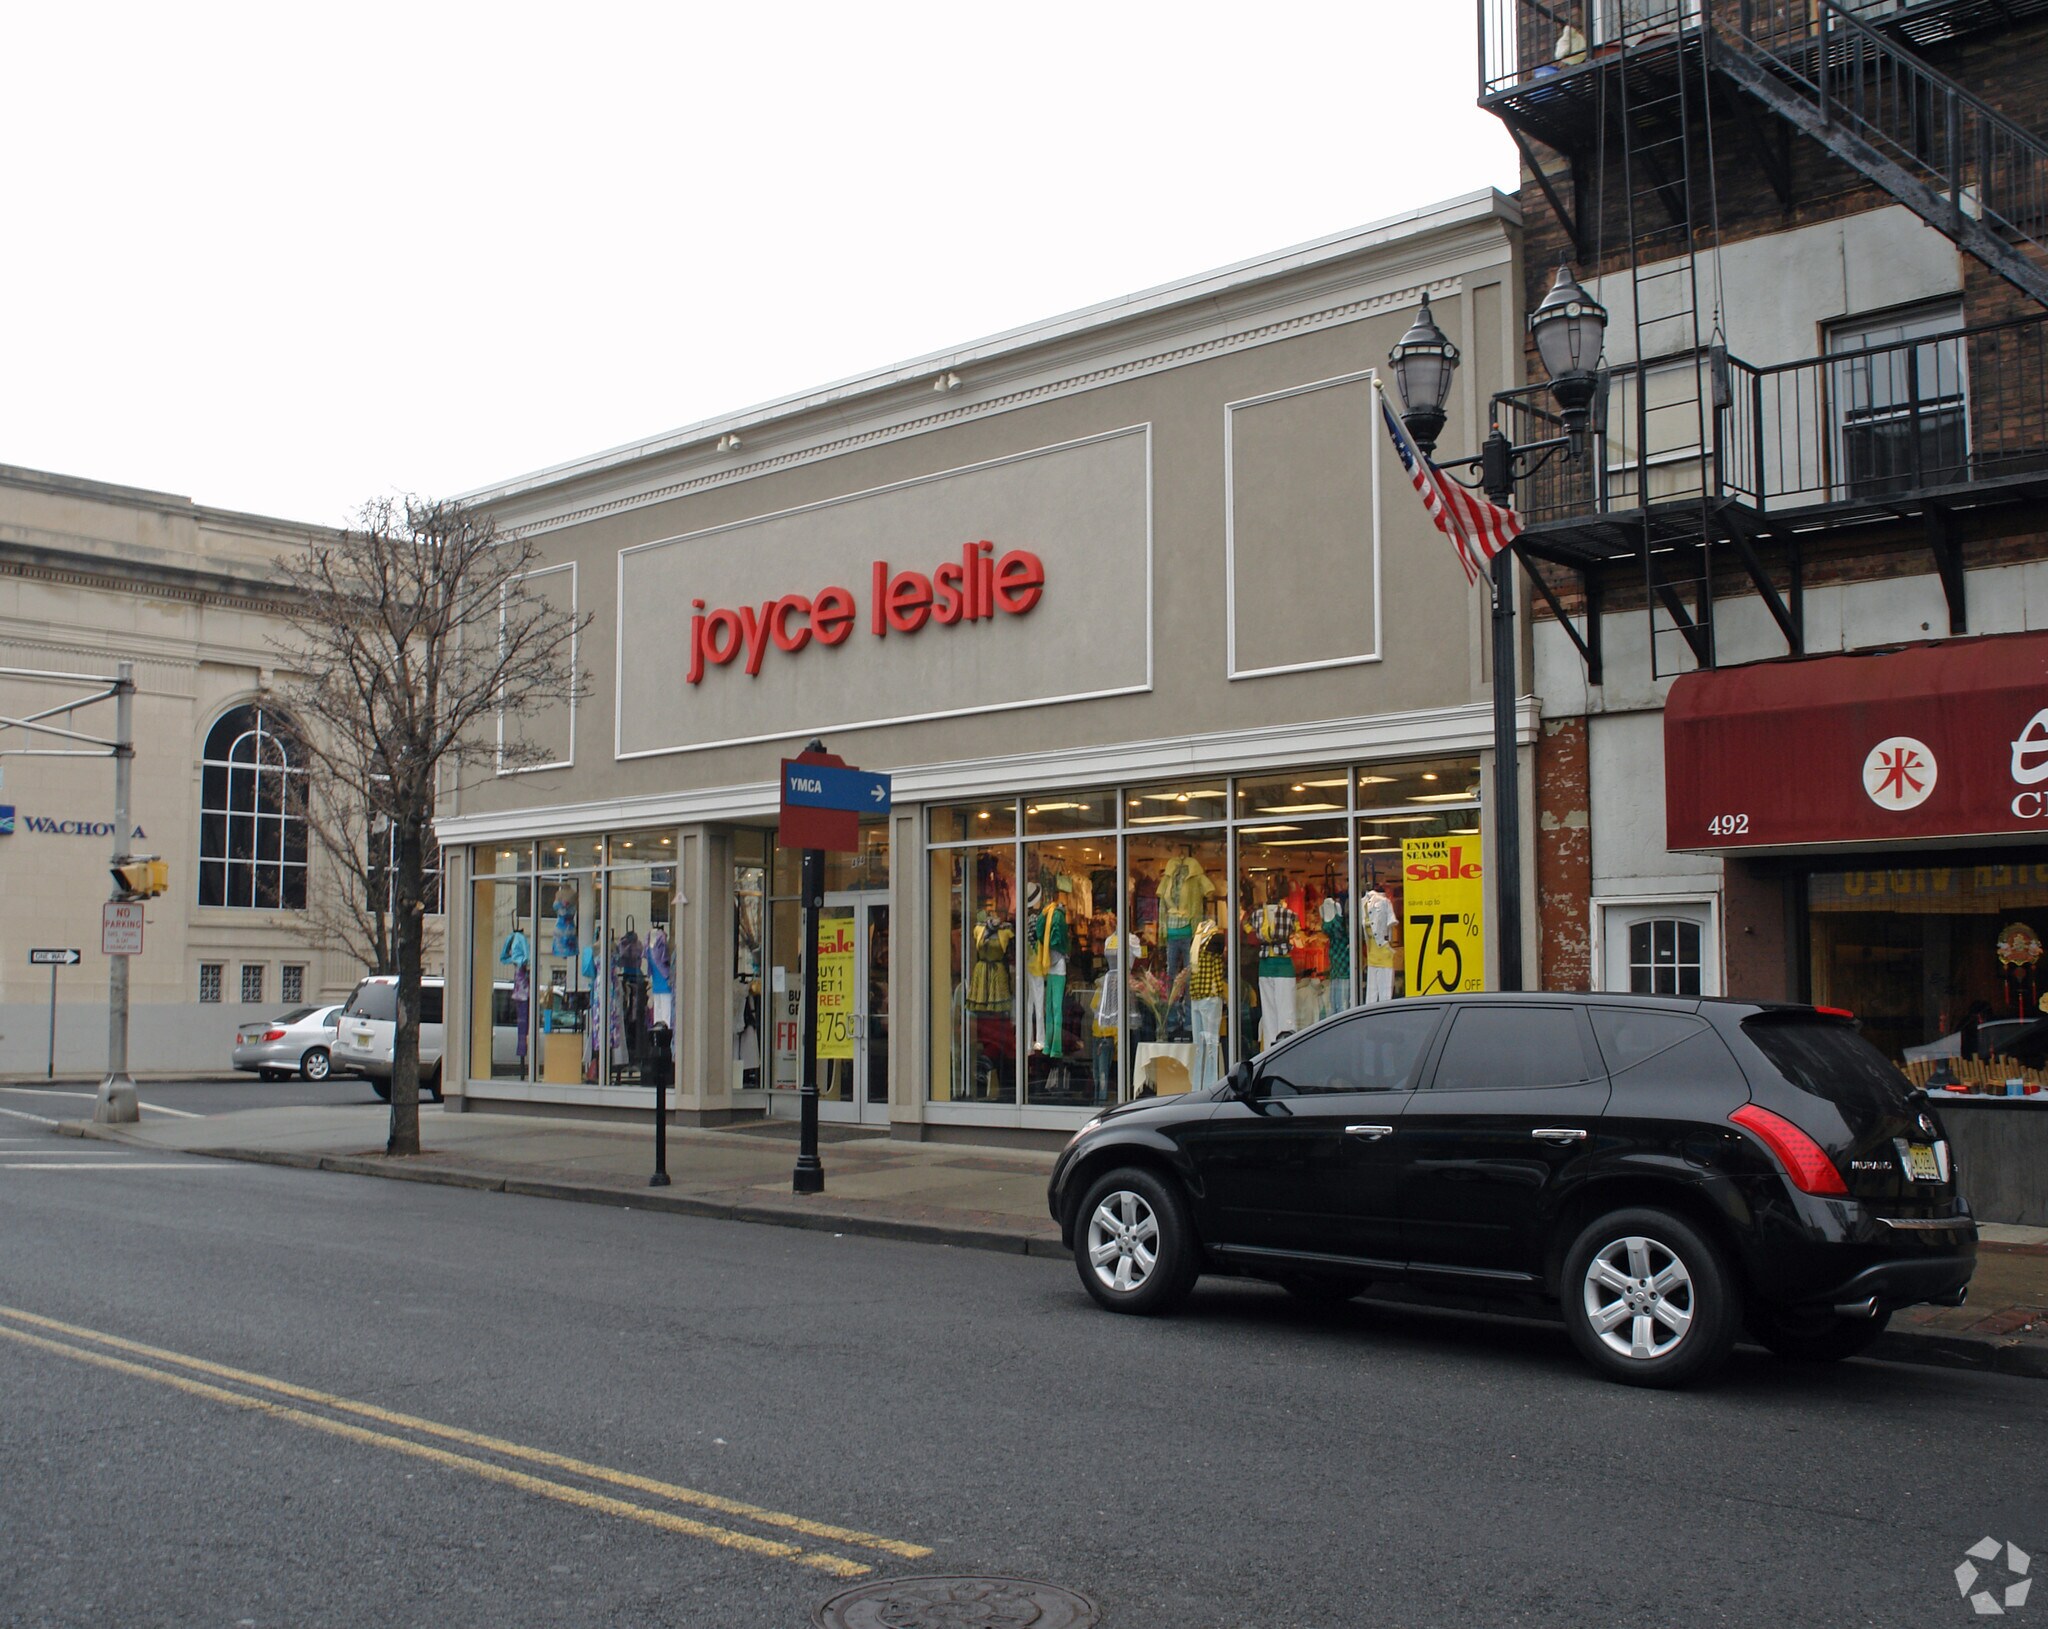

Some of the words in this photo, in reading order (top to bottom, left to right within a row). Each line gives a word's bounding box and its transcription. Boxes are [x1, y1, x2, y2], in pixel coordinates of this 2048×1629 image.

[686, 586, 856, 684] joyce
[871, 540, 1045, 637] leslie
[1873, 747, 1925, 799] 米
[790, 777, 822, 793] YMCA
[24, 816, 147, 839] WACHOVA
[1707, 813, 1749, 836] 492
[1407, 842, 1430, 850] END
[1433, 841, 1448, 849] OF
[1406, 850, 1448, 859] SEASON
[1406, 846, 1482, 881] sale
[1434, 898, 1441, 906] to
[116, 908, 131, 918] NO
[104, 920, 141, 929] PARKING
[818, 966, 835, 978] UY
[1465, 979, 1482, 991] OFF
[1851, 1160, 1892, 1170] MURANO
